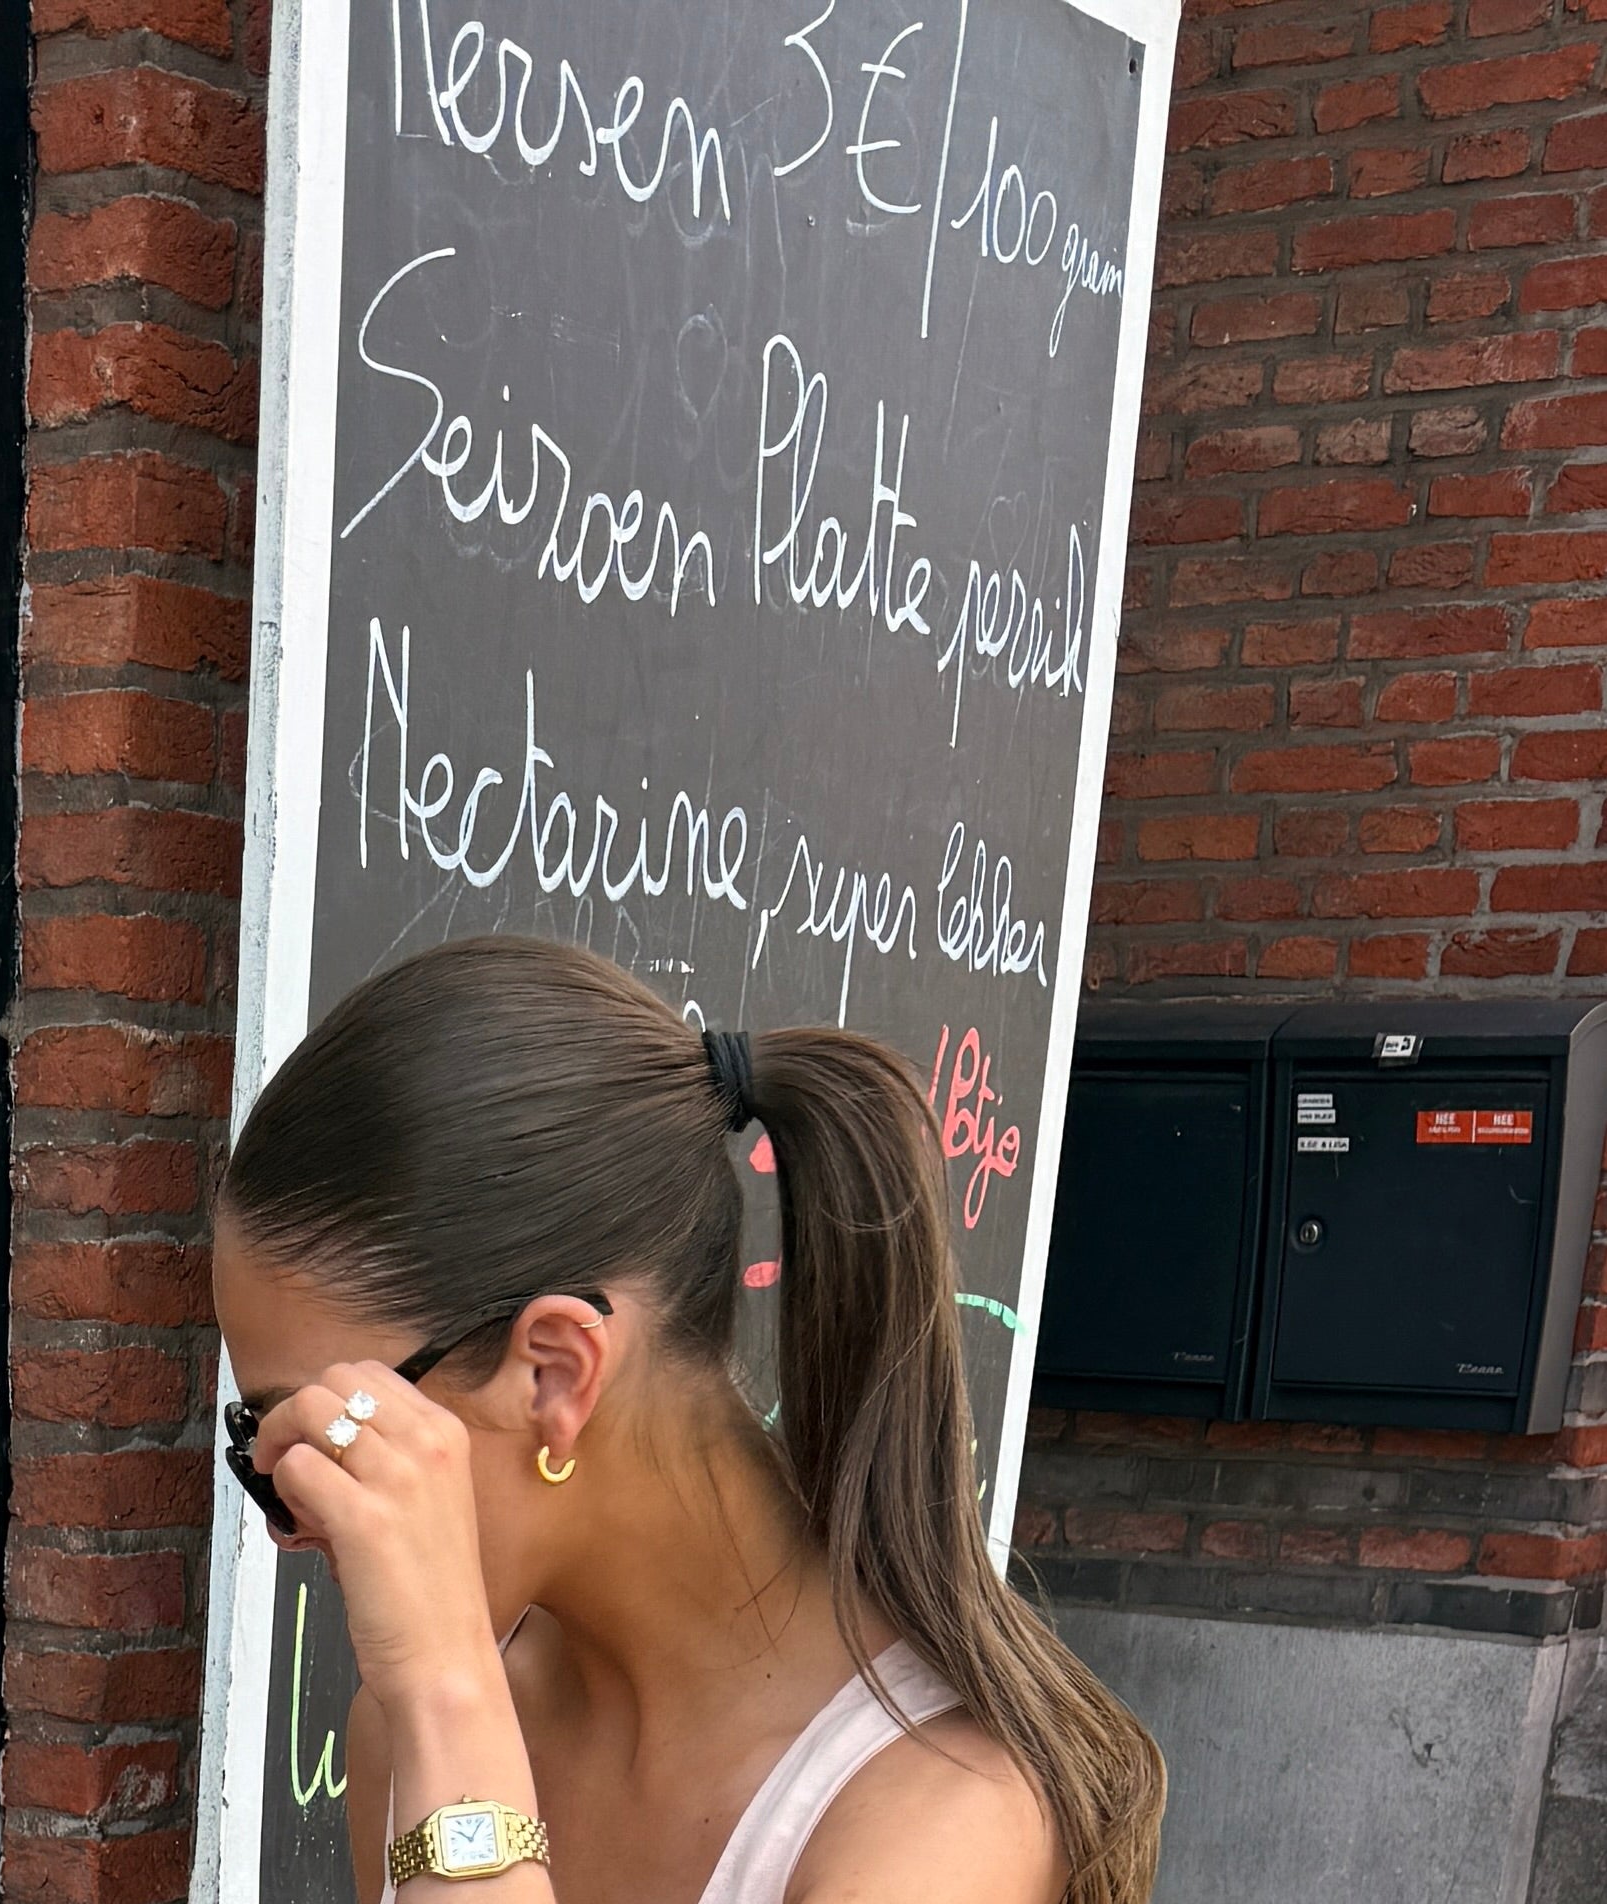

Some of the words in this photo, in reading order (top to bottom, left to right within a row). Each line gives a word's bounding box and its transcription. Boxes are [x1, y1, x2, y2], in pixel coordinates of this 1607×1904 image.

[753, 334, 931, 632] Platte
[770, 834, 917, 1029] super
[937, 821, 1047, 988] lekker
